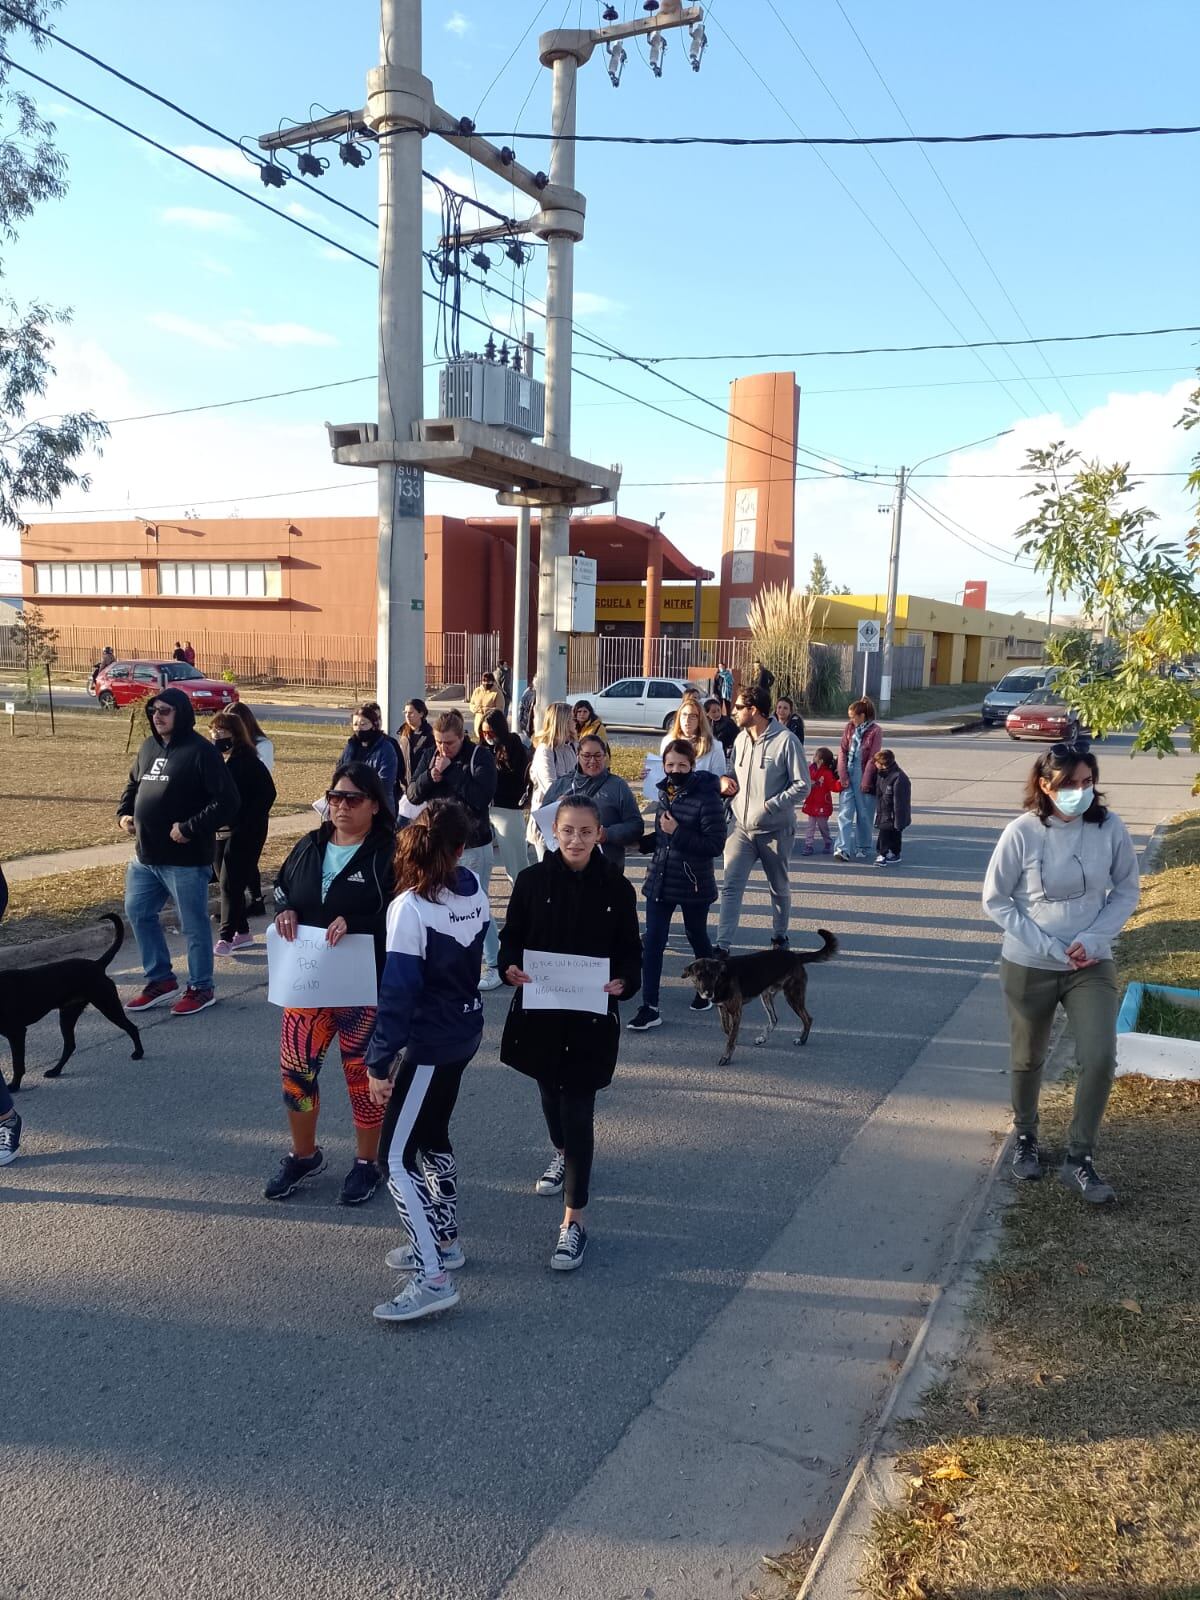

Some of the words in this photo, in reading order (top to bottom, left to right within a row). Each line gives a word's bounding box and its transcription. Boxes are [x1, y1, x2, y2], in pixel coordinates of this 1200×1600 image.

[398, 465, 418, 477] SUB
[398, 477, 421, 499] 133
[595, 598, 631, 608] SCUELA
[663, 599, 693, 608] MITRE
